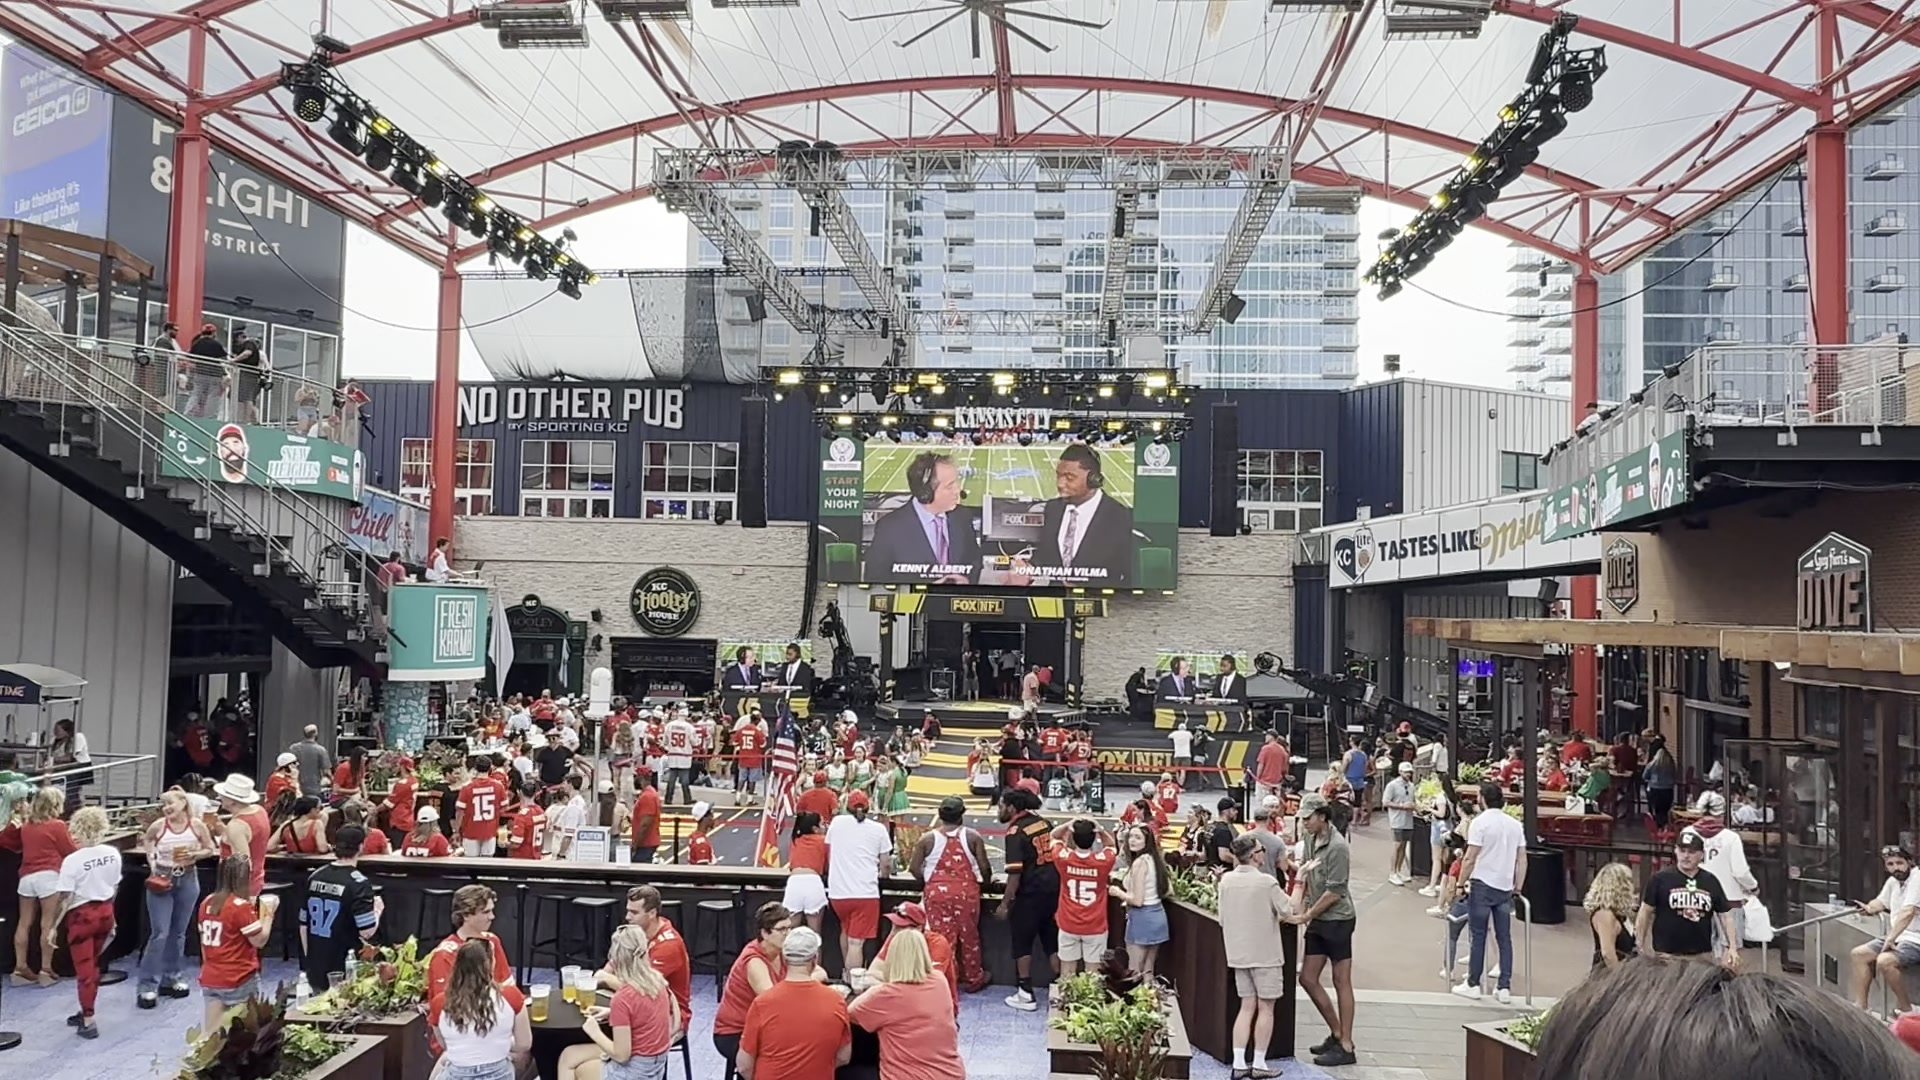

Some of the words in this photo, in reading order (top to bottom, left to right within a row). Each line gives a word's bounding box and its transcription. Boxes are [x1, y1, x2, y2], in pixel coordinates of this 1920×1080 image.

[13, 94, 71, 136] GEICO
[31, 186, 66, 206] thinking
[206, 172, 309, 228] IGHT
[204, 230, 280, 256] ISTRICT
[456, 386, 497, 428] NO
[507, 387, 611, 420] OTHER
[623, 388, 683, 430] PUB
[508, 422, 522, 430] BY
[527, 421, 604, 432] SPORTING
[608, 422, 627, 432] KC
[825, 477, 859, 485] START
[826, 488, 857, 498] YOUR
[824, 499, 860, 509] NIGHT
[1378, 534, 1437, 561] TASTES
[1441, 529, 1482, 554] LIKE
[1336, 549, 1352, 567] KC
[892, 564, 930, 574] KENNY
[931, 564, 973, 575] ALBERT
[1074, 567, 1108, 578] VILMA
[1606, 555, 1634, 589] DIVE
[635, 589, 694, 614] HOOLEY
[953, 600, 977, 612] FOX
[980, 601, 1003, 613] NFL
[1800, 570, 1862, 628] DIVE
[440, 600, 474, 629] FRESH
[648, 612, 680, 620] HOUSE
[439, 628, 473, 657] KARMA
[671, 732, 685, 747] 58
[742, 735, 754, 750] 15
[473, 794, 496, 821] 15
[83, 855, 115, 871] STAFF
[1067, 879, 1098, 907] 15
[1669, 891, 1711, 911] CHIEFS
[202, 920, 223, 947] 87
